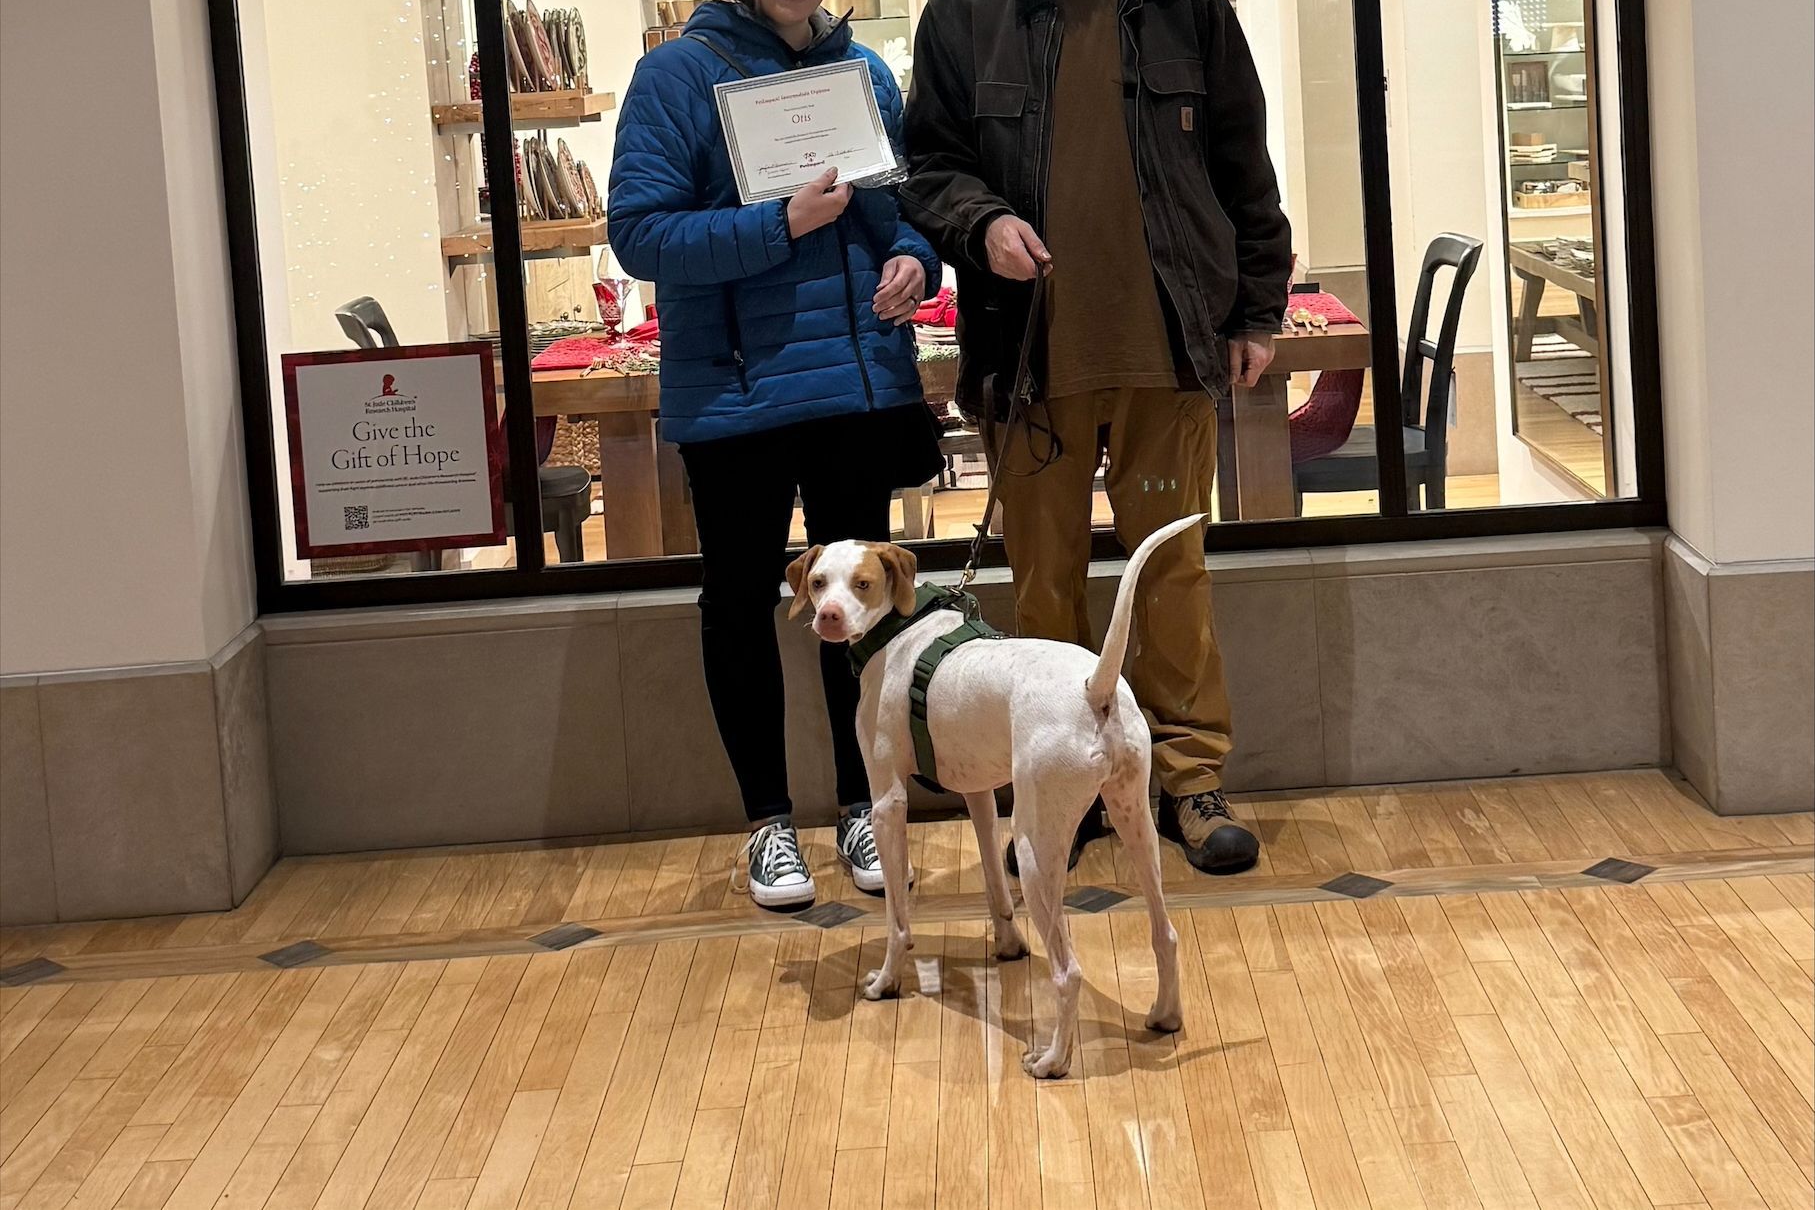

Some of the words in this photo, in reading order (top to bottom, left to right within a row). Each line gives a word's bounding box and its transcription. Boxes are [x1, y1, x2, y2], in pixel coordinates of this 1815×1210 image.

[792, 114, 811, 124] Otis
[352, 421, 398, 441] Give
[405, 416, 435, 438] the
[331, 447, 372, 470] Gift
[377, 444, 399, 467] of
[403, 444, 460, 471] Hope
